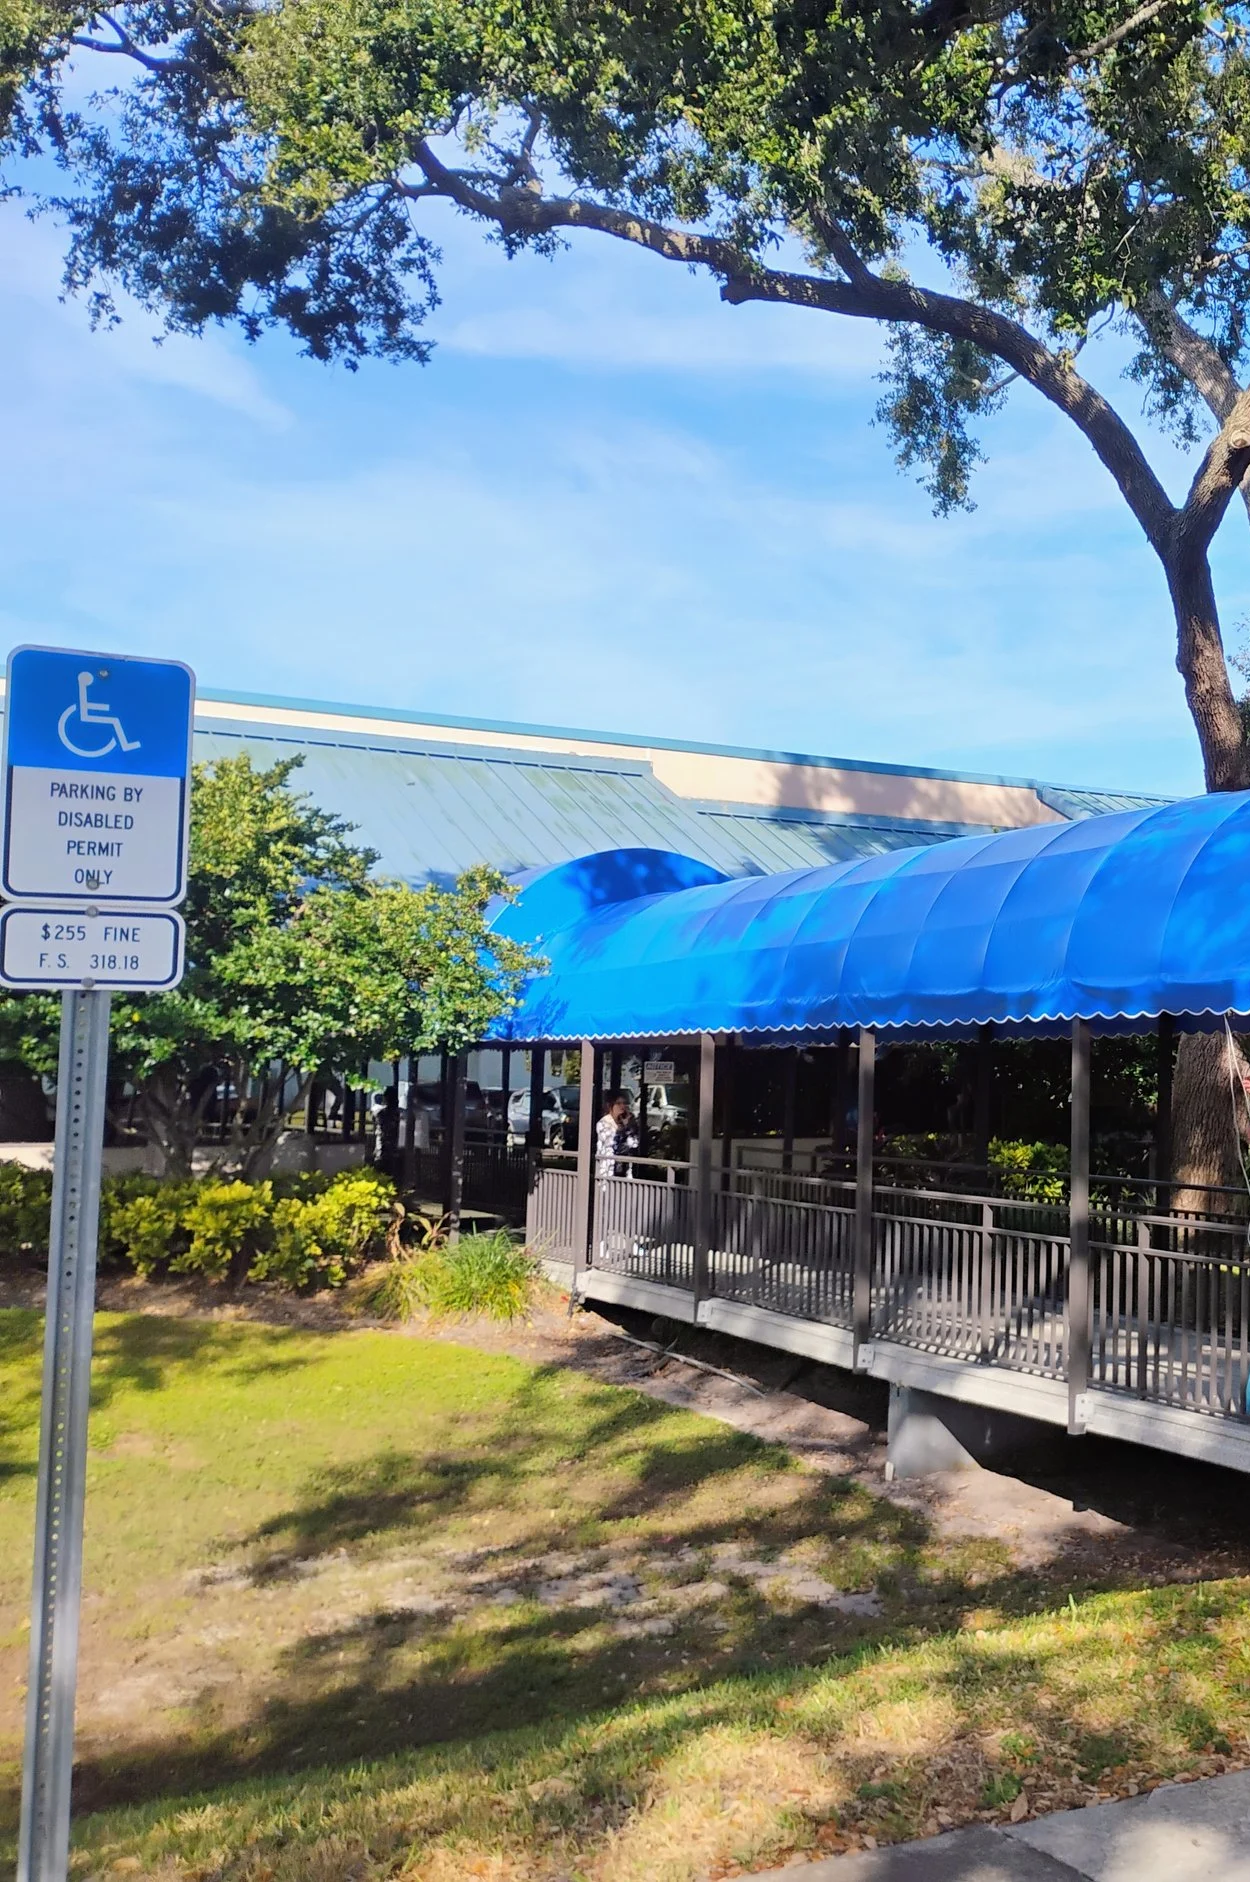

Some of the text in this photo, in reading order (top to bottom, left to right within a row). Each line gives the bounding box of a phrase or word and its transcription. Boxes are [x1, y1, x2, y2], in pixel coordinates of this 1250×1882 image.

[50, 782, 143, 803] PARKING BY
[58, 811, 134, 830] DISABLED
[67, 840, 123, 857] PERMIT
[74, 868, 113, 885] ONLY
[41, 922, 141, 943] $255 FINE
[89, 954, 139, 970] 318.18
